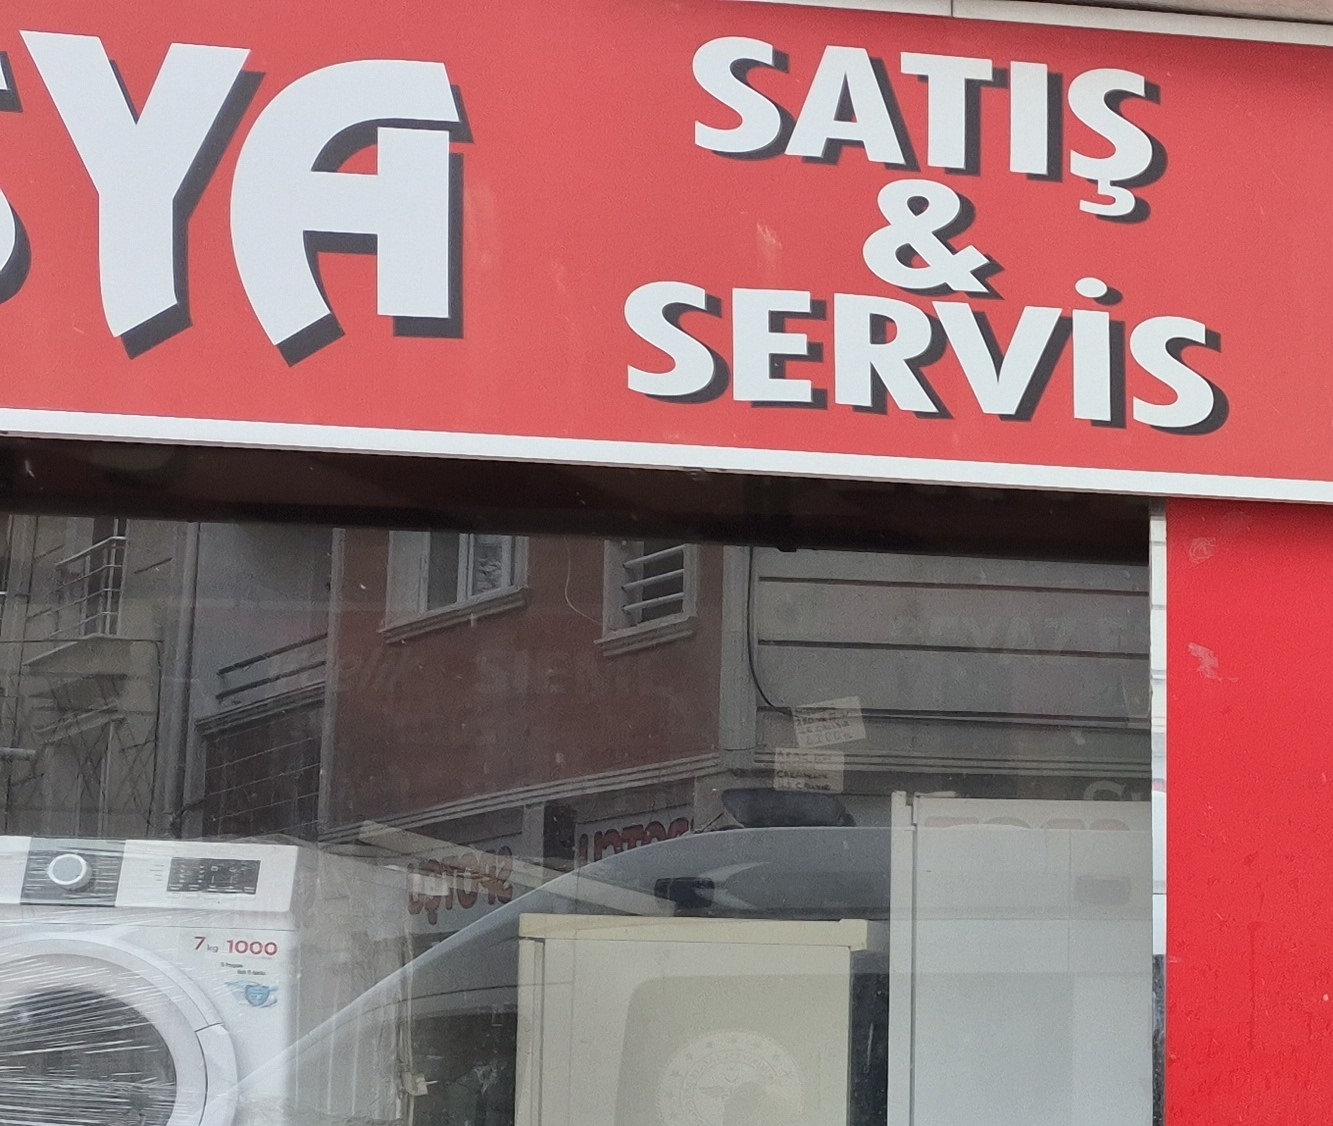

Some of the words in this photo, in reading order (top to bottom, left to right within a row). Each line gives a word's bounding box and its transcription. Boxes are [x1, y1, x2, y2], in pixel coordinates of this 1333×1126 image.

[0, 28, 462, 355] YA
[691, 35, 1160, 220] SATIŞ
[862, 178, 992, 294] &
[625, 277, 1224, 432] SERVİS
[193, 936, 206, 951] 7
[227, 939, 278, 956] 1000
